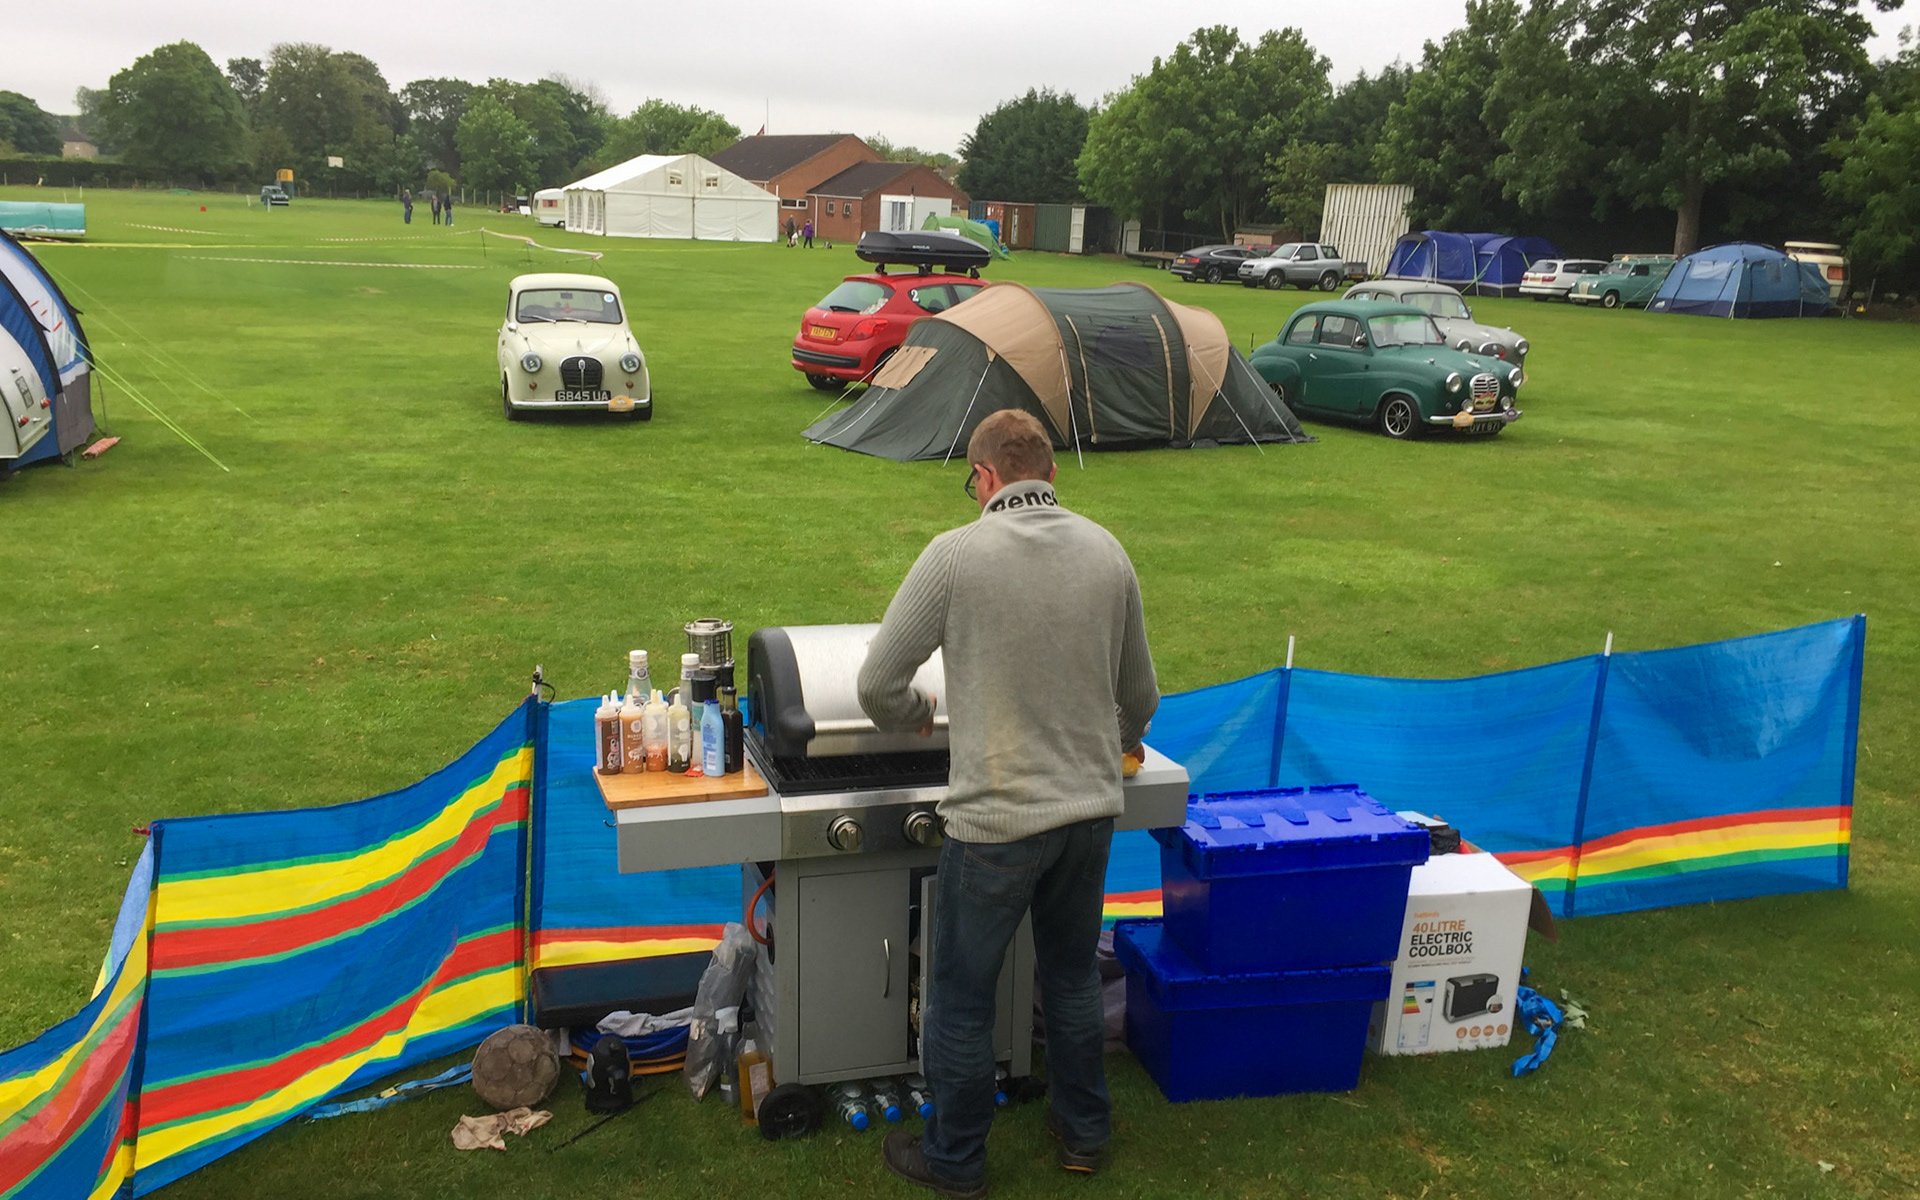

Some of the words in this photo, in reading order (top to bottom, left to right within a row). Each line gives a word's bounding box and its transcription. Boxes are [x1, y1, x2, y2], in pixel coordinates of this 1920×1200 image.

[911, 289, 919, 302] 2
[557, 391, 590, 401] 6845
[592, 391, 609, 401] UA
[1413, 922, 1428, 933] 40
[1430, 919, 1466, 932] LITRE
[1410, 931, 1473, 946] ELECTRIC
[1408, 943, 1473, 958] COOLBOX
